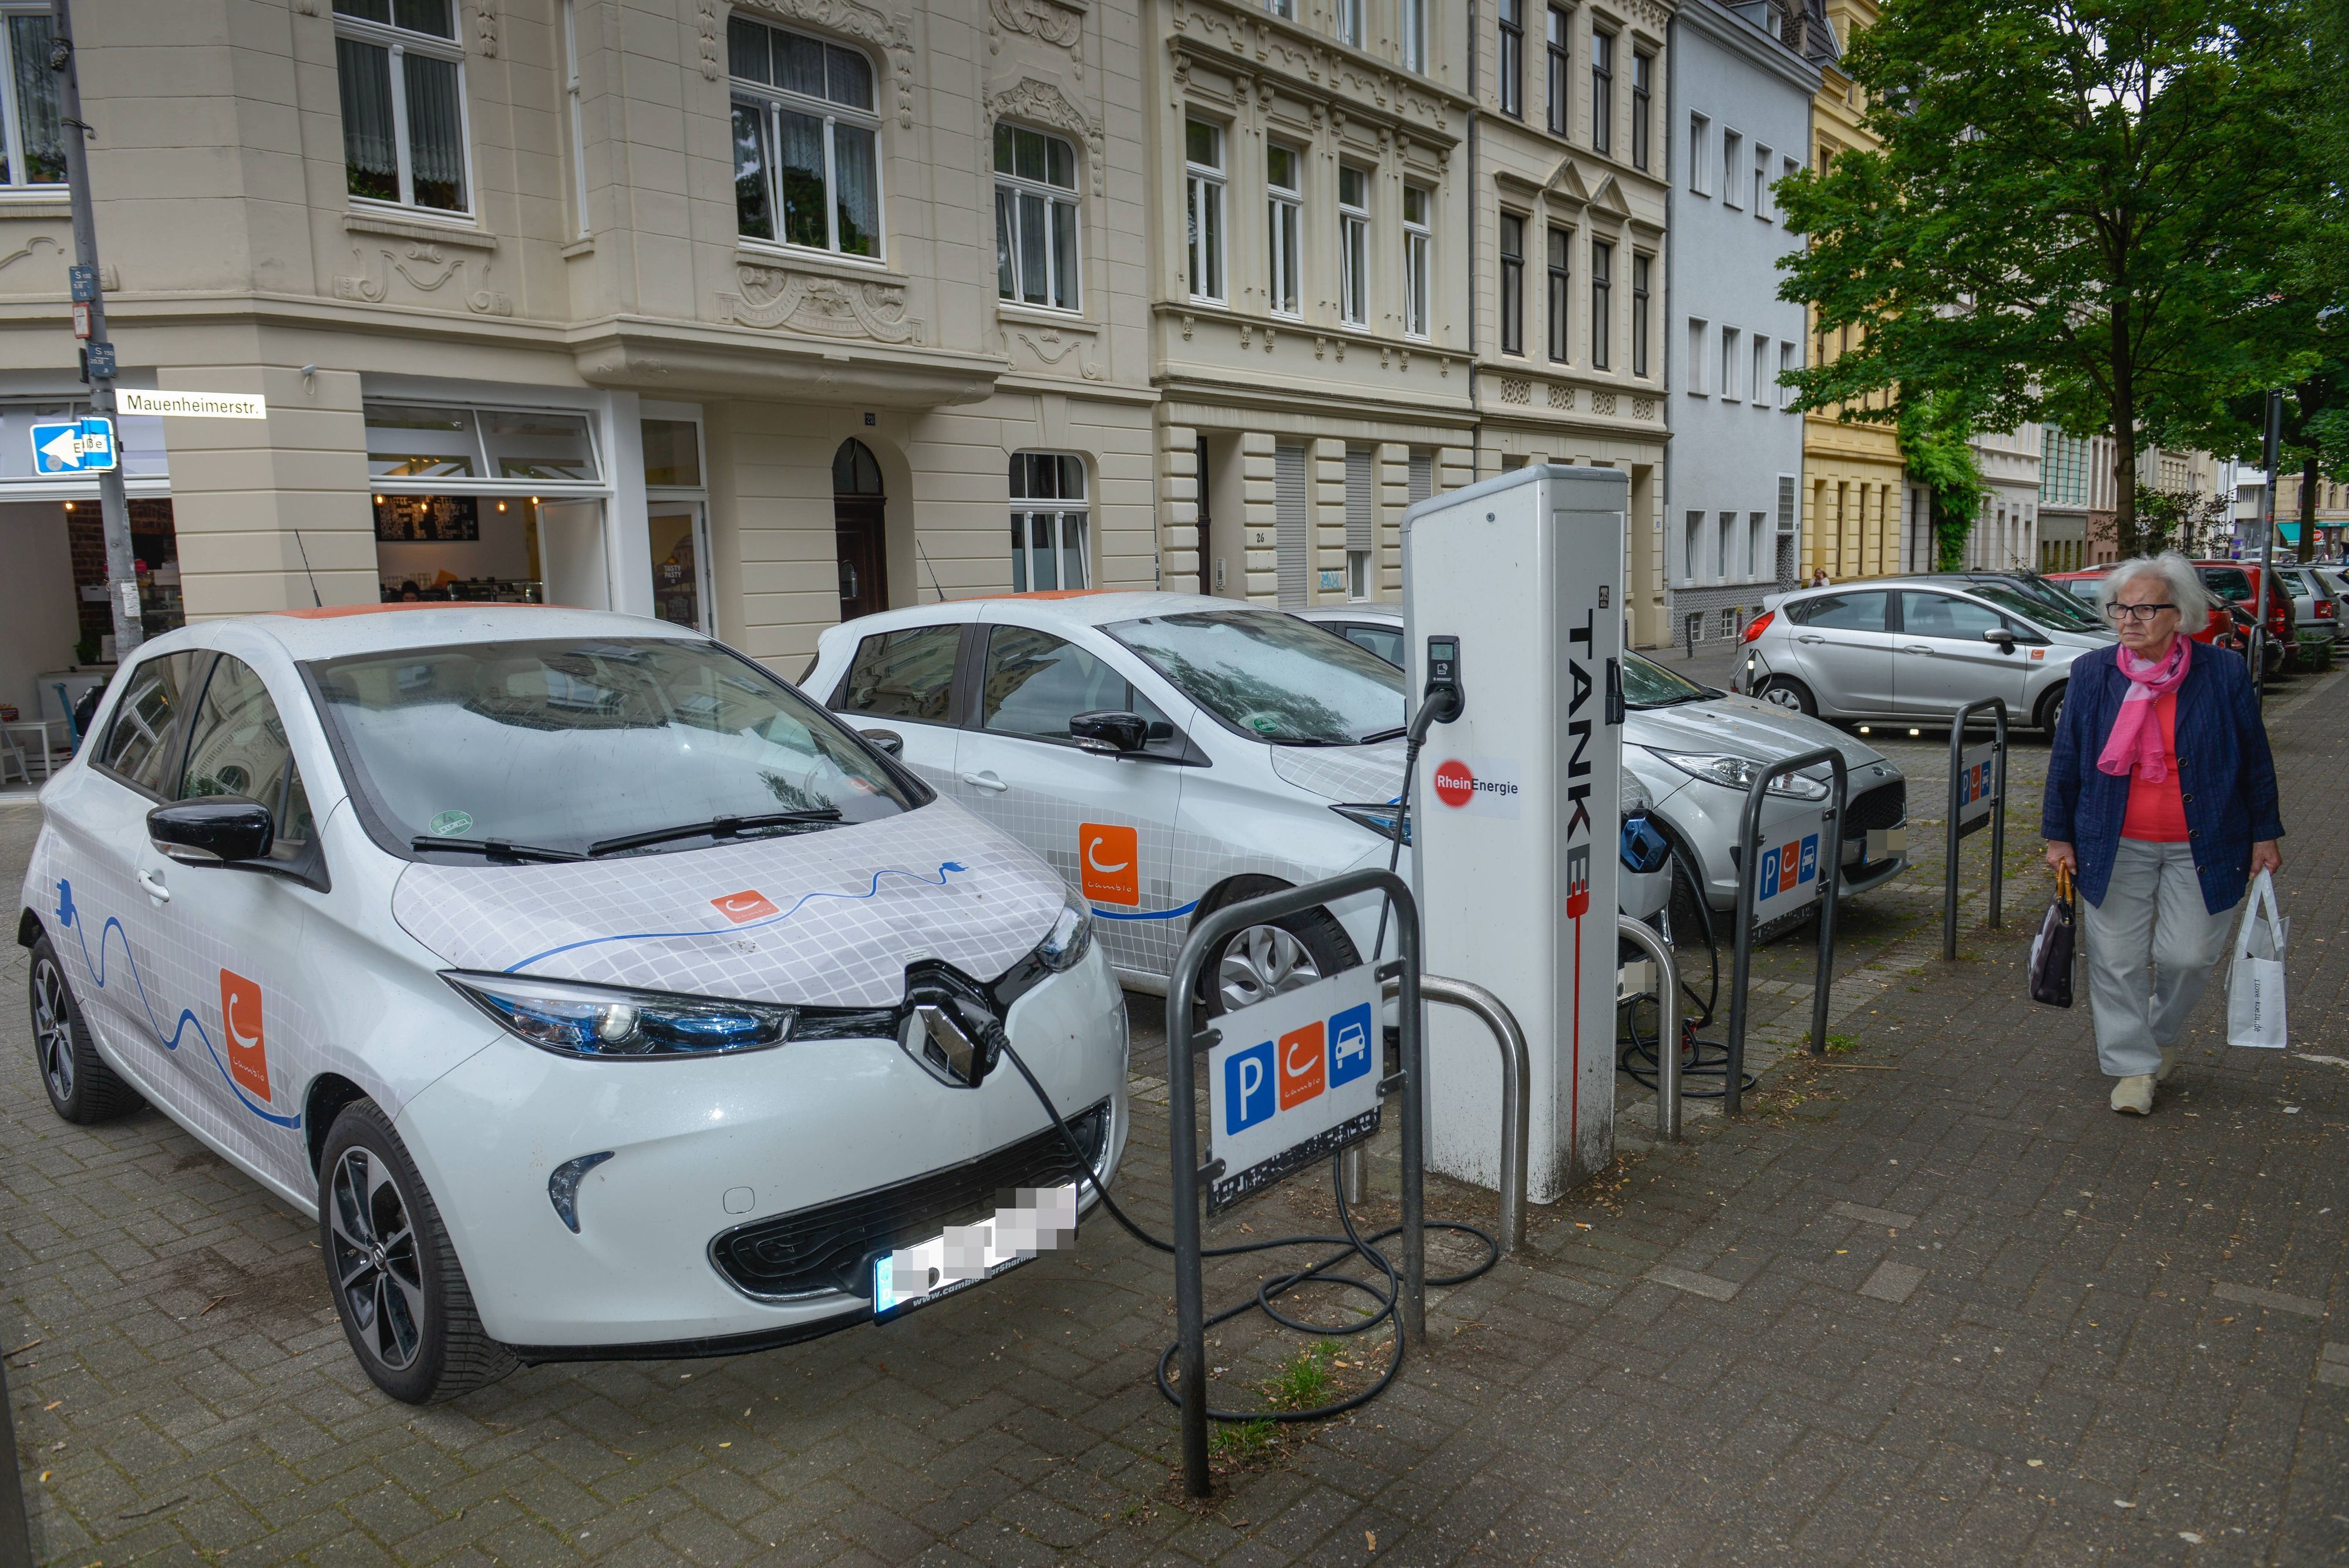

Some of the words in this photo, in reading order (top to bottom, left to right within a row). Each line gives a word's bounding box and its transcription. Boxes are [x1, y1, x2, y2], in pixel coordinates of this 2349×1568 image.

[75, 271, 82, 280] S
[127, 395, 258, 414] Mauenheimerstr.
[1256, 533, 1264, 543] 26
[1567, 608, 1593, 899] TANKE
[1438, 775, 1518, 796] RheinEnergie
[1765, 855, 1776, 894] P
[1088, 880, 1133, 893] cambio
[233, 1056, 264, 1081] cambio
[1239, 1056, 1263, 1122] P
[1284, 1078, 1321, 1098] cambio
